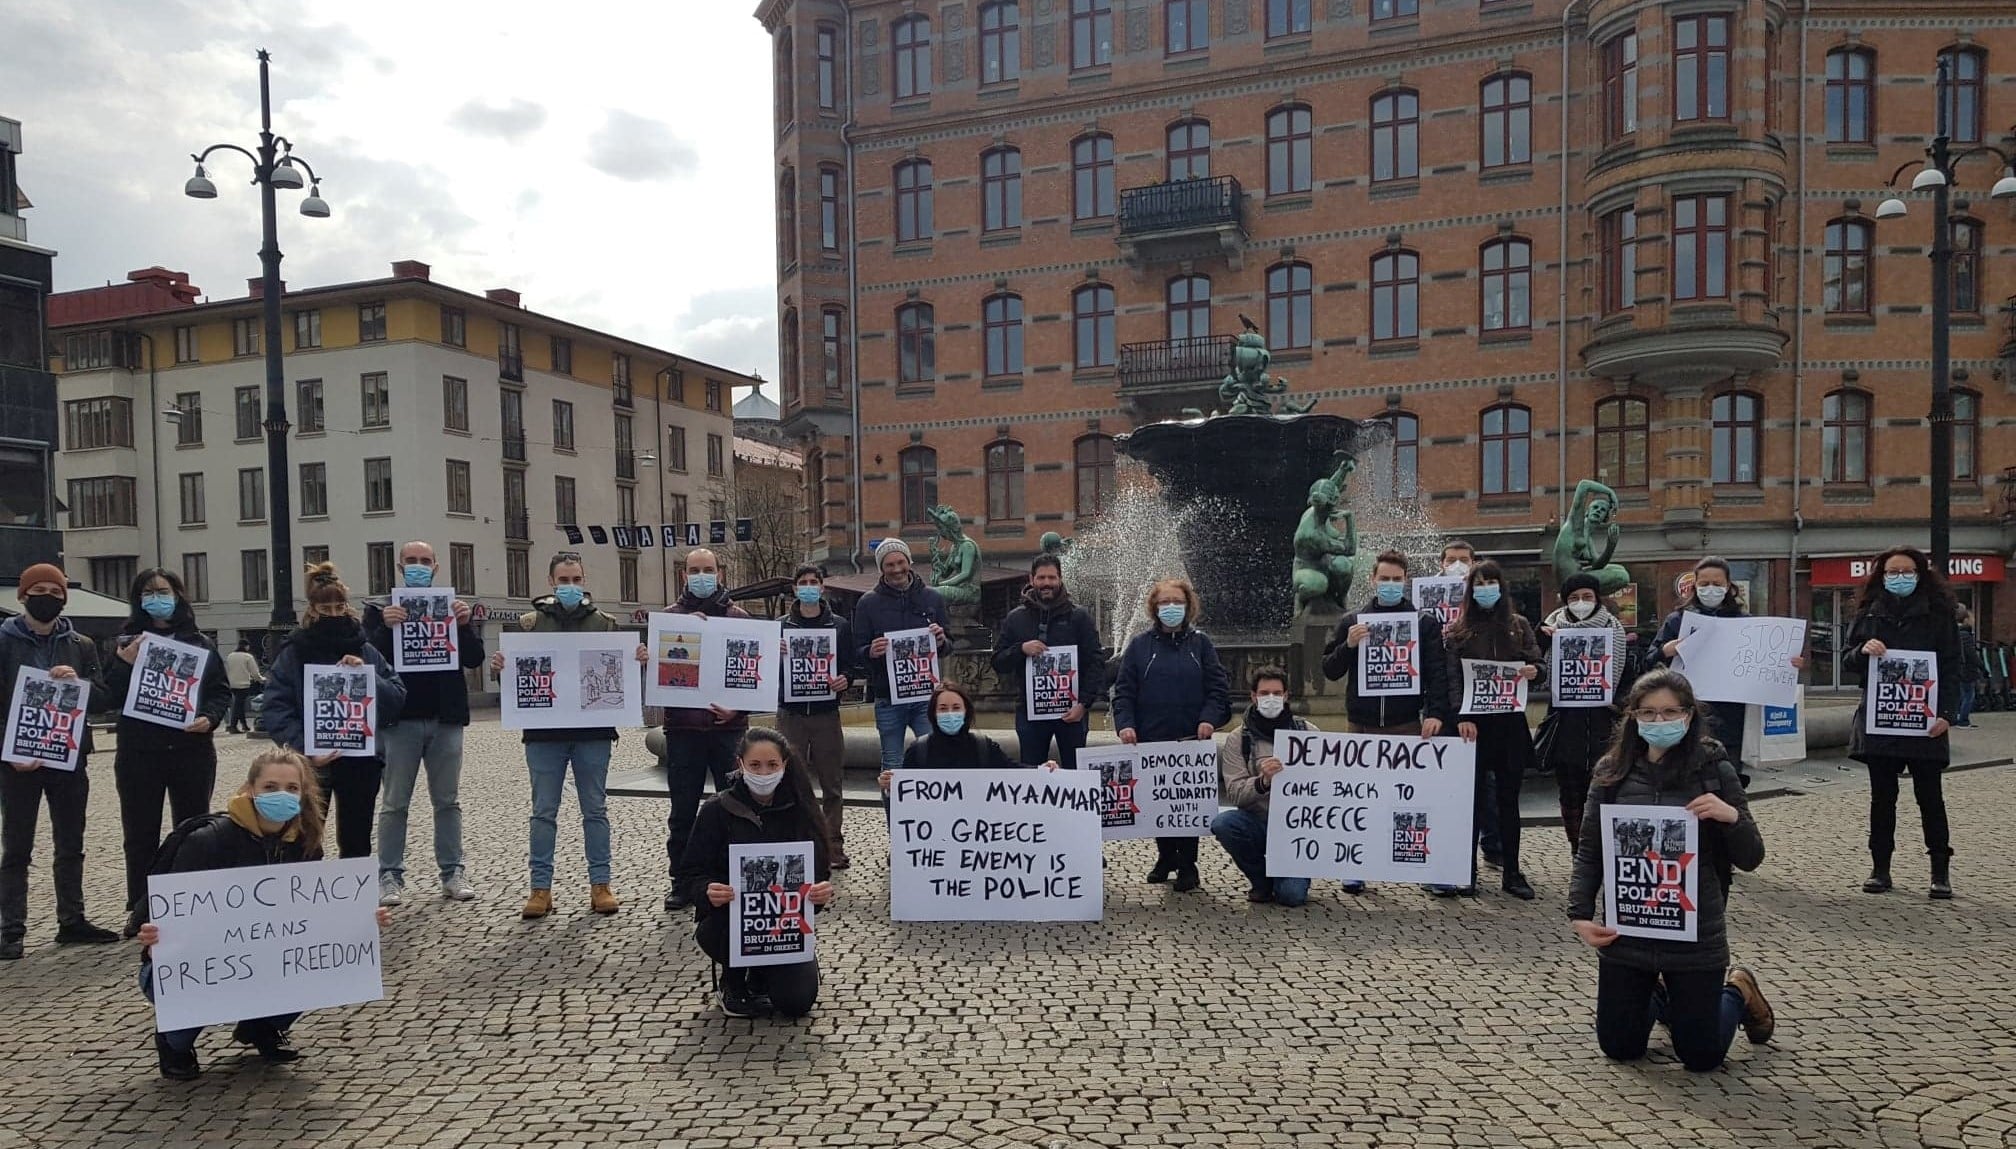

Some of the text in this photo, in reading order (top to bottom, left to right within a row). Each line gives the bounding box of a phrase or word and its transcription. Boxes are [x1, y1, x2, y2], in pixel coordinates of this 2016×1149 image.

[403, 621, 447, 638] END
[403, 639, 447, 649] POLICE
[1738, 624, 1804, 653] STOP
[404, 650, 446, 658] BRUTALITY
[1367, 646, 1409, 662] END
[1732, 648, 1789, 668] ABUSE
[727, 657, 757, 670] END
[792, 658, 828, 672] END
[895, 657, 930, 674] END
[1367, 663, 1409, 673] POLICE
[1561, 660, 1602, 675] END
[1733, 664, 1756, 677] OF
[727, 669, 756, 677] POLICE
[792, 673, 828, 682] POLICE
[897, 672, 930, 684] POLICE
[1367, 674, 1409, 682] BRUTALITY
[1561, 676, 1602, 685] POLICE
[142, 668, 188, 694] END
[518, 675, 550, 688] END
[1034, 675, 1070, 690] END
[1474, 679, 1515, 694] END
[140, 685, 186, 705] POLICE
[518, 688, 551, 696] POLICE
[1034, 691, 1070, 700] POLICE
[1878, 683, 1926, 700] END
[138, 696, 185, 713] BRUTALITY
[1473, 695, 1513, 704] POLICE
[1877, 701, 1925, 712] POLICE
[315, 700, 365, 718] END
[20, 706, 72, 730] END
[315, 719, 365, 731] POLICE
[1877, 713, 1924, 722] BRUTALITY
[18, 726, 69, 743] POLICE
[316, 732, 363, 741] BRUTALITY
[16, 739, 66, 752] BRUTALITY
[1285, 735, 1448, 770] DEMOCRACY
[1141, 753, 1217, 770] DEMOCRACY
[1153, 774, 1166, 786] IN
[897, 779, 1101, 816] FROM MYANMAR
[1152, 787, 1217, 801] SOLIDARITY
[1282, 781, 1414, 800] CAME BACK TO
[1100, 801, 1131, 812] OLICE
[1170, 803, 1198, 813] WITH
[1156, 814, 1210, 829] GREECE
[1286, 806, 1369, 832] GREECE
[898, 818, 1048, 844] TO GREECE
[1394, 830, 1425, 843] END
[1290, 837, 1364, 864] TO DIE
[1394, 843, 1425, 851] POLICE
[906, 848, 1066, 874] THE ENEMY IS
[1617, 857, 1682, 884] END
[929, 876, 1084, 900] THE POLICE
[1617, 885, 1681, 903] POLICE
[150, 874, 370, 920] DEMOCRACY
[743, 891, 801, 916] END
[1618, 903, 1680, 917] BRUTALITY
[743, 917, 801, 932] POLICE
[1639, 917, 1648, 925] IN
[224, 919, 308, 944] MEANS
[743, 933, 800, 944] BRUTALITY
[157, 940, 375, 996] PRESS FREEDOM
